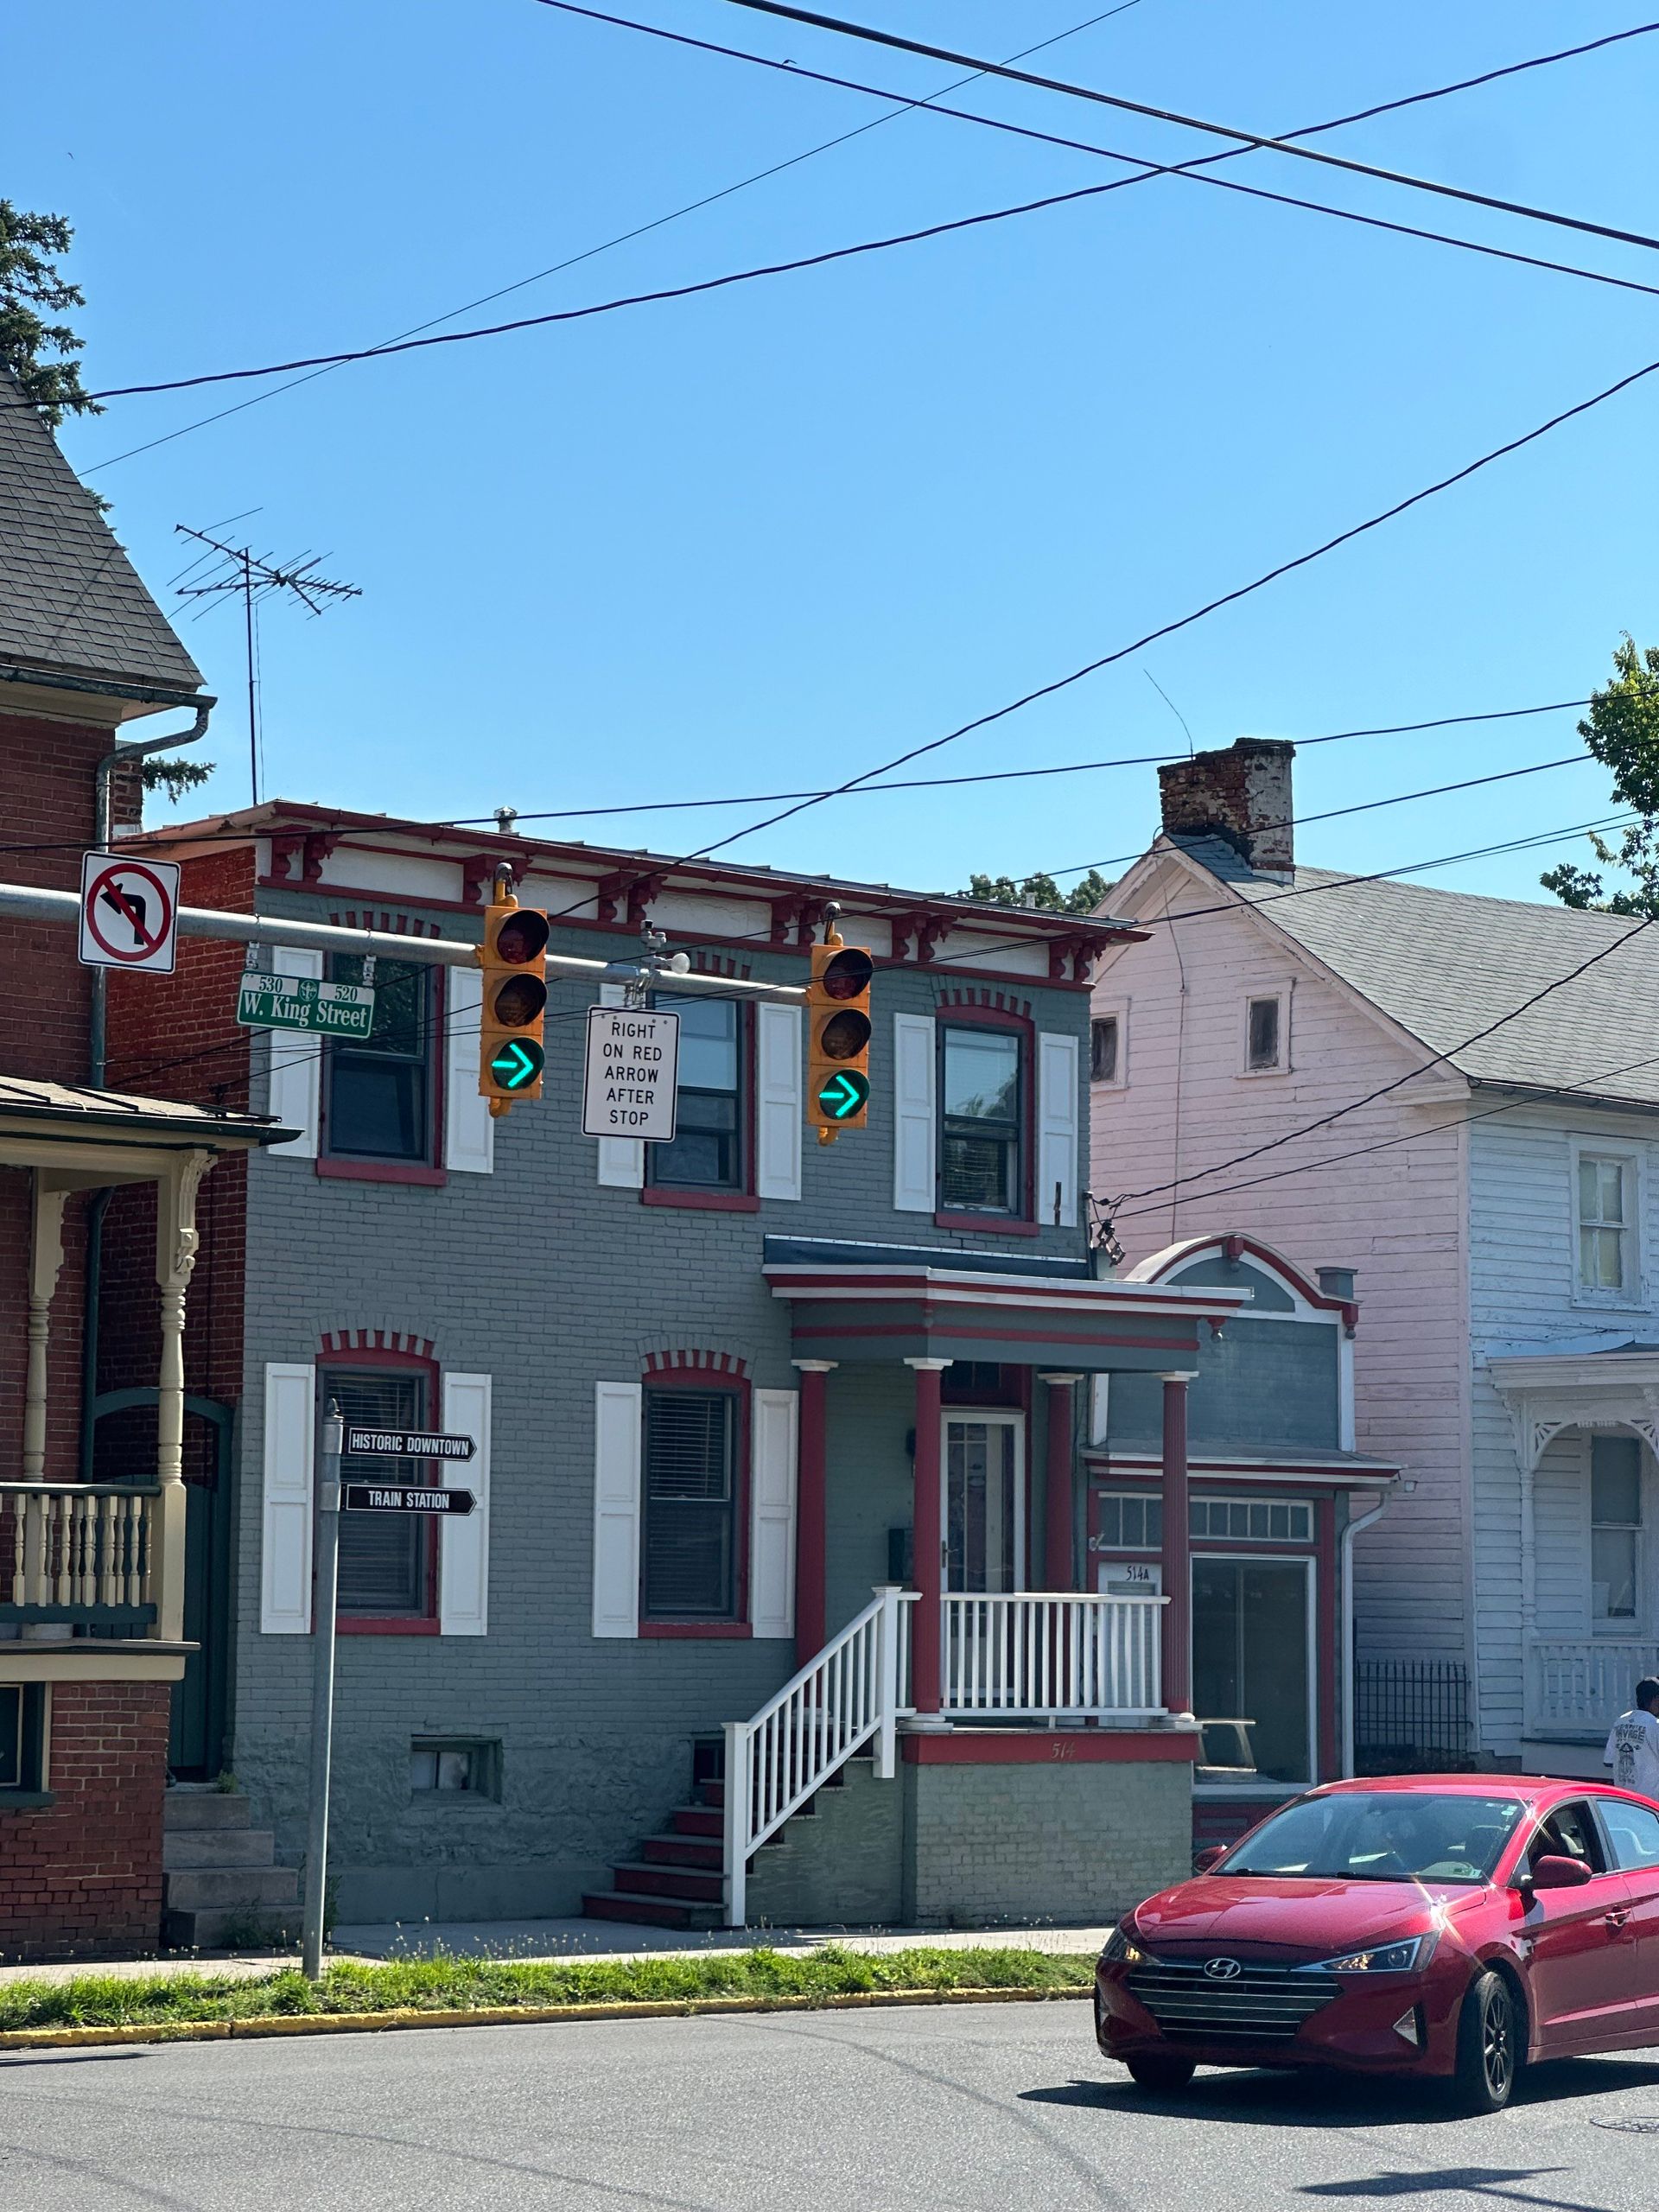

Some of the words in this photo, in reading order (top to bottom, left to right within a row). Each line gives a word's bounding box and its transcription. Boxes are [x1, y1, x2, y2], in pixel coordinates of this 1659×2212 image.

[258, 976, 283, 993] 530
[334, 985, 358, 1002] 520
[244, 991, 264, 1016] W.
[270, 995, 311, 1027] King
[316, 1000, 366, 1027] Street
[612, 1022, 656, 1039] RIGHT
[603, 1043, 623, 1058] ON
[633, 1046, 662, 1061] RED
[605, 1065, 658, 1083] ARROW
[607, 1088, 654, 1104] AFTER
[609, 1109, 649, 1126] STOP
[352, 1433, 403, 1452] HISTORIC
[407, 1436, 469, 1456] DOWNTOWN
[368, 1490, 402, 1507] TRAIN
[406, 1491, 450, 1509] STATION
[1126, 1565, 1149, 1581] 514A
[1050, 1741, 1077, 1759] 514
